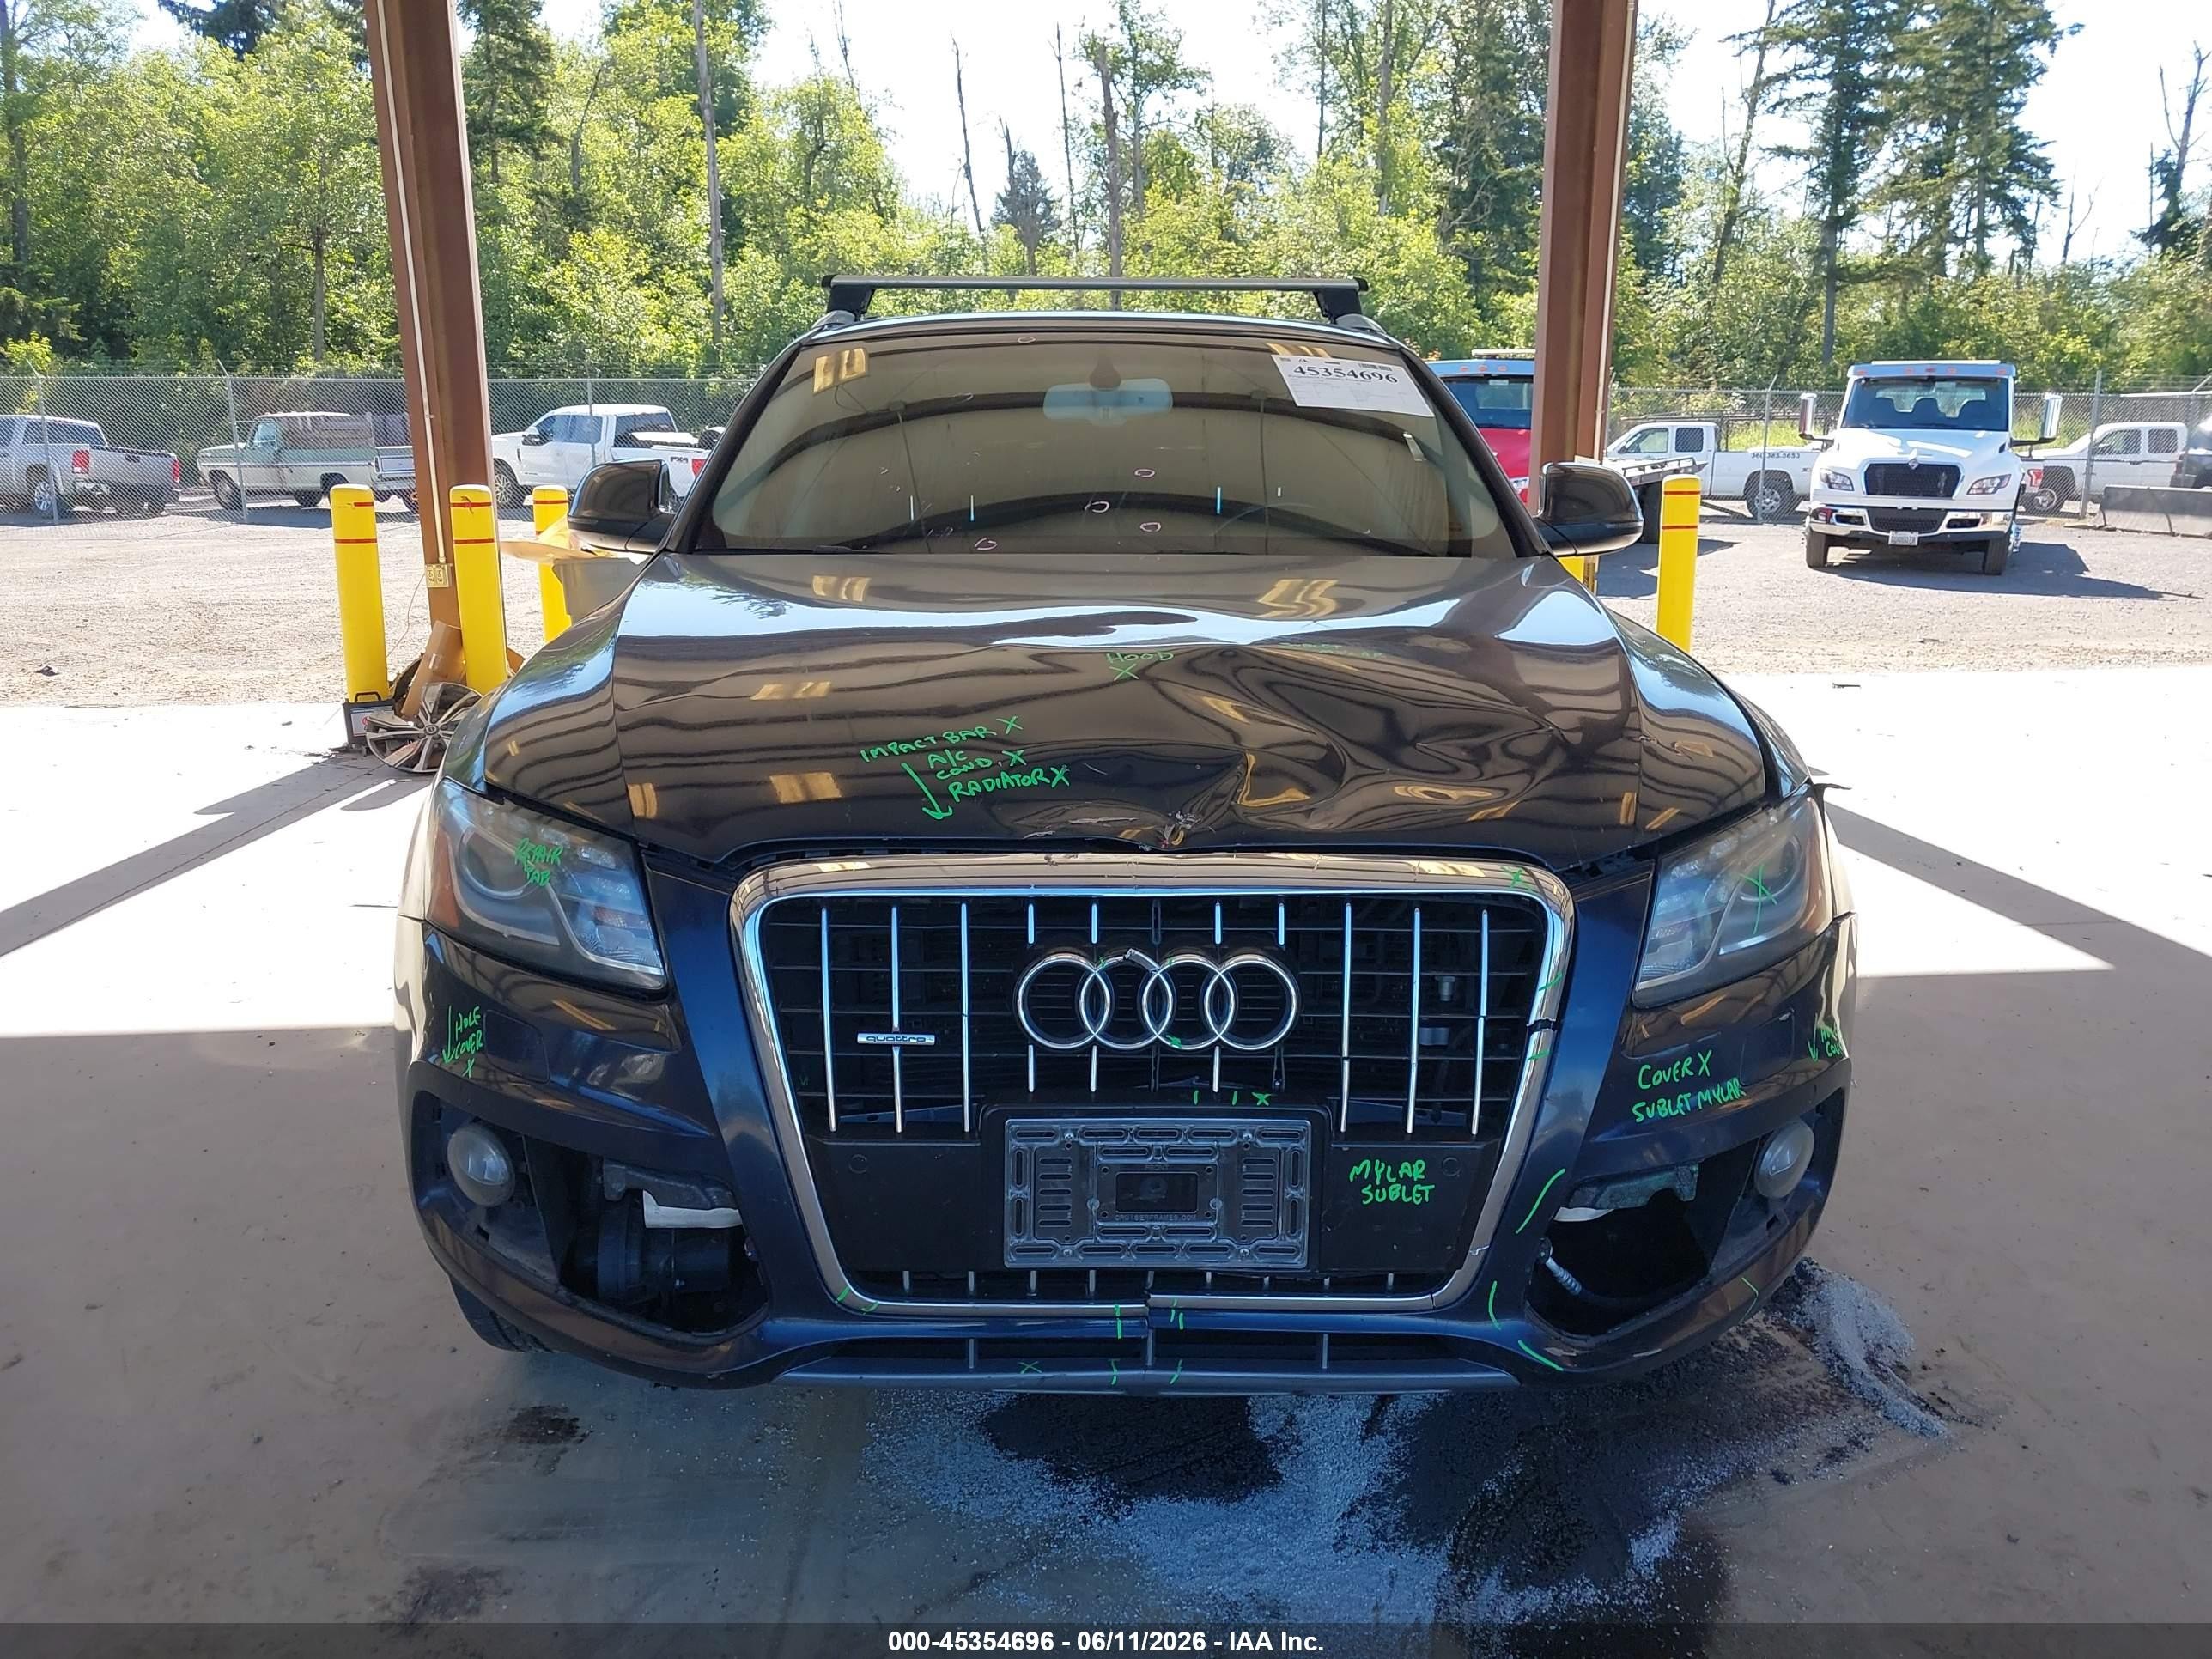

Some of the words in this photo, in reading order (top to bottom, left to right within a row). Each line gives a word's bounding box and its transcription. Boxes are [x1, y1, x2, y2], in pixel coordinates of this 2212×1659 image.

[1293, 365, 1398, 383] 45354696
[1105, 652, 1174, 664] HOOD
[860, 736, 937, 763] IMPACT
[943, 726, 998, 744] BAR
[927, 749, 968, 769] A/C
[948, 767, 1051, 803] RADIATOR
[455, 1006, 481, 1042] HOLE
[454, 1029, 483, 1060] COVER
[866, 1035, 927, 1043] quattro
[1638, 1056, 1694, 1090] COVER
[1632, 1093, 1692, 1123] SUBLET
[1697, 1076, 1747, 1110] MYLAR
[1348, 1158, 1426, 1185] MYLAR
[1360, 1183, 1436, 1205] SUBLET
